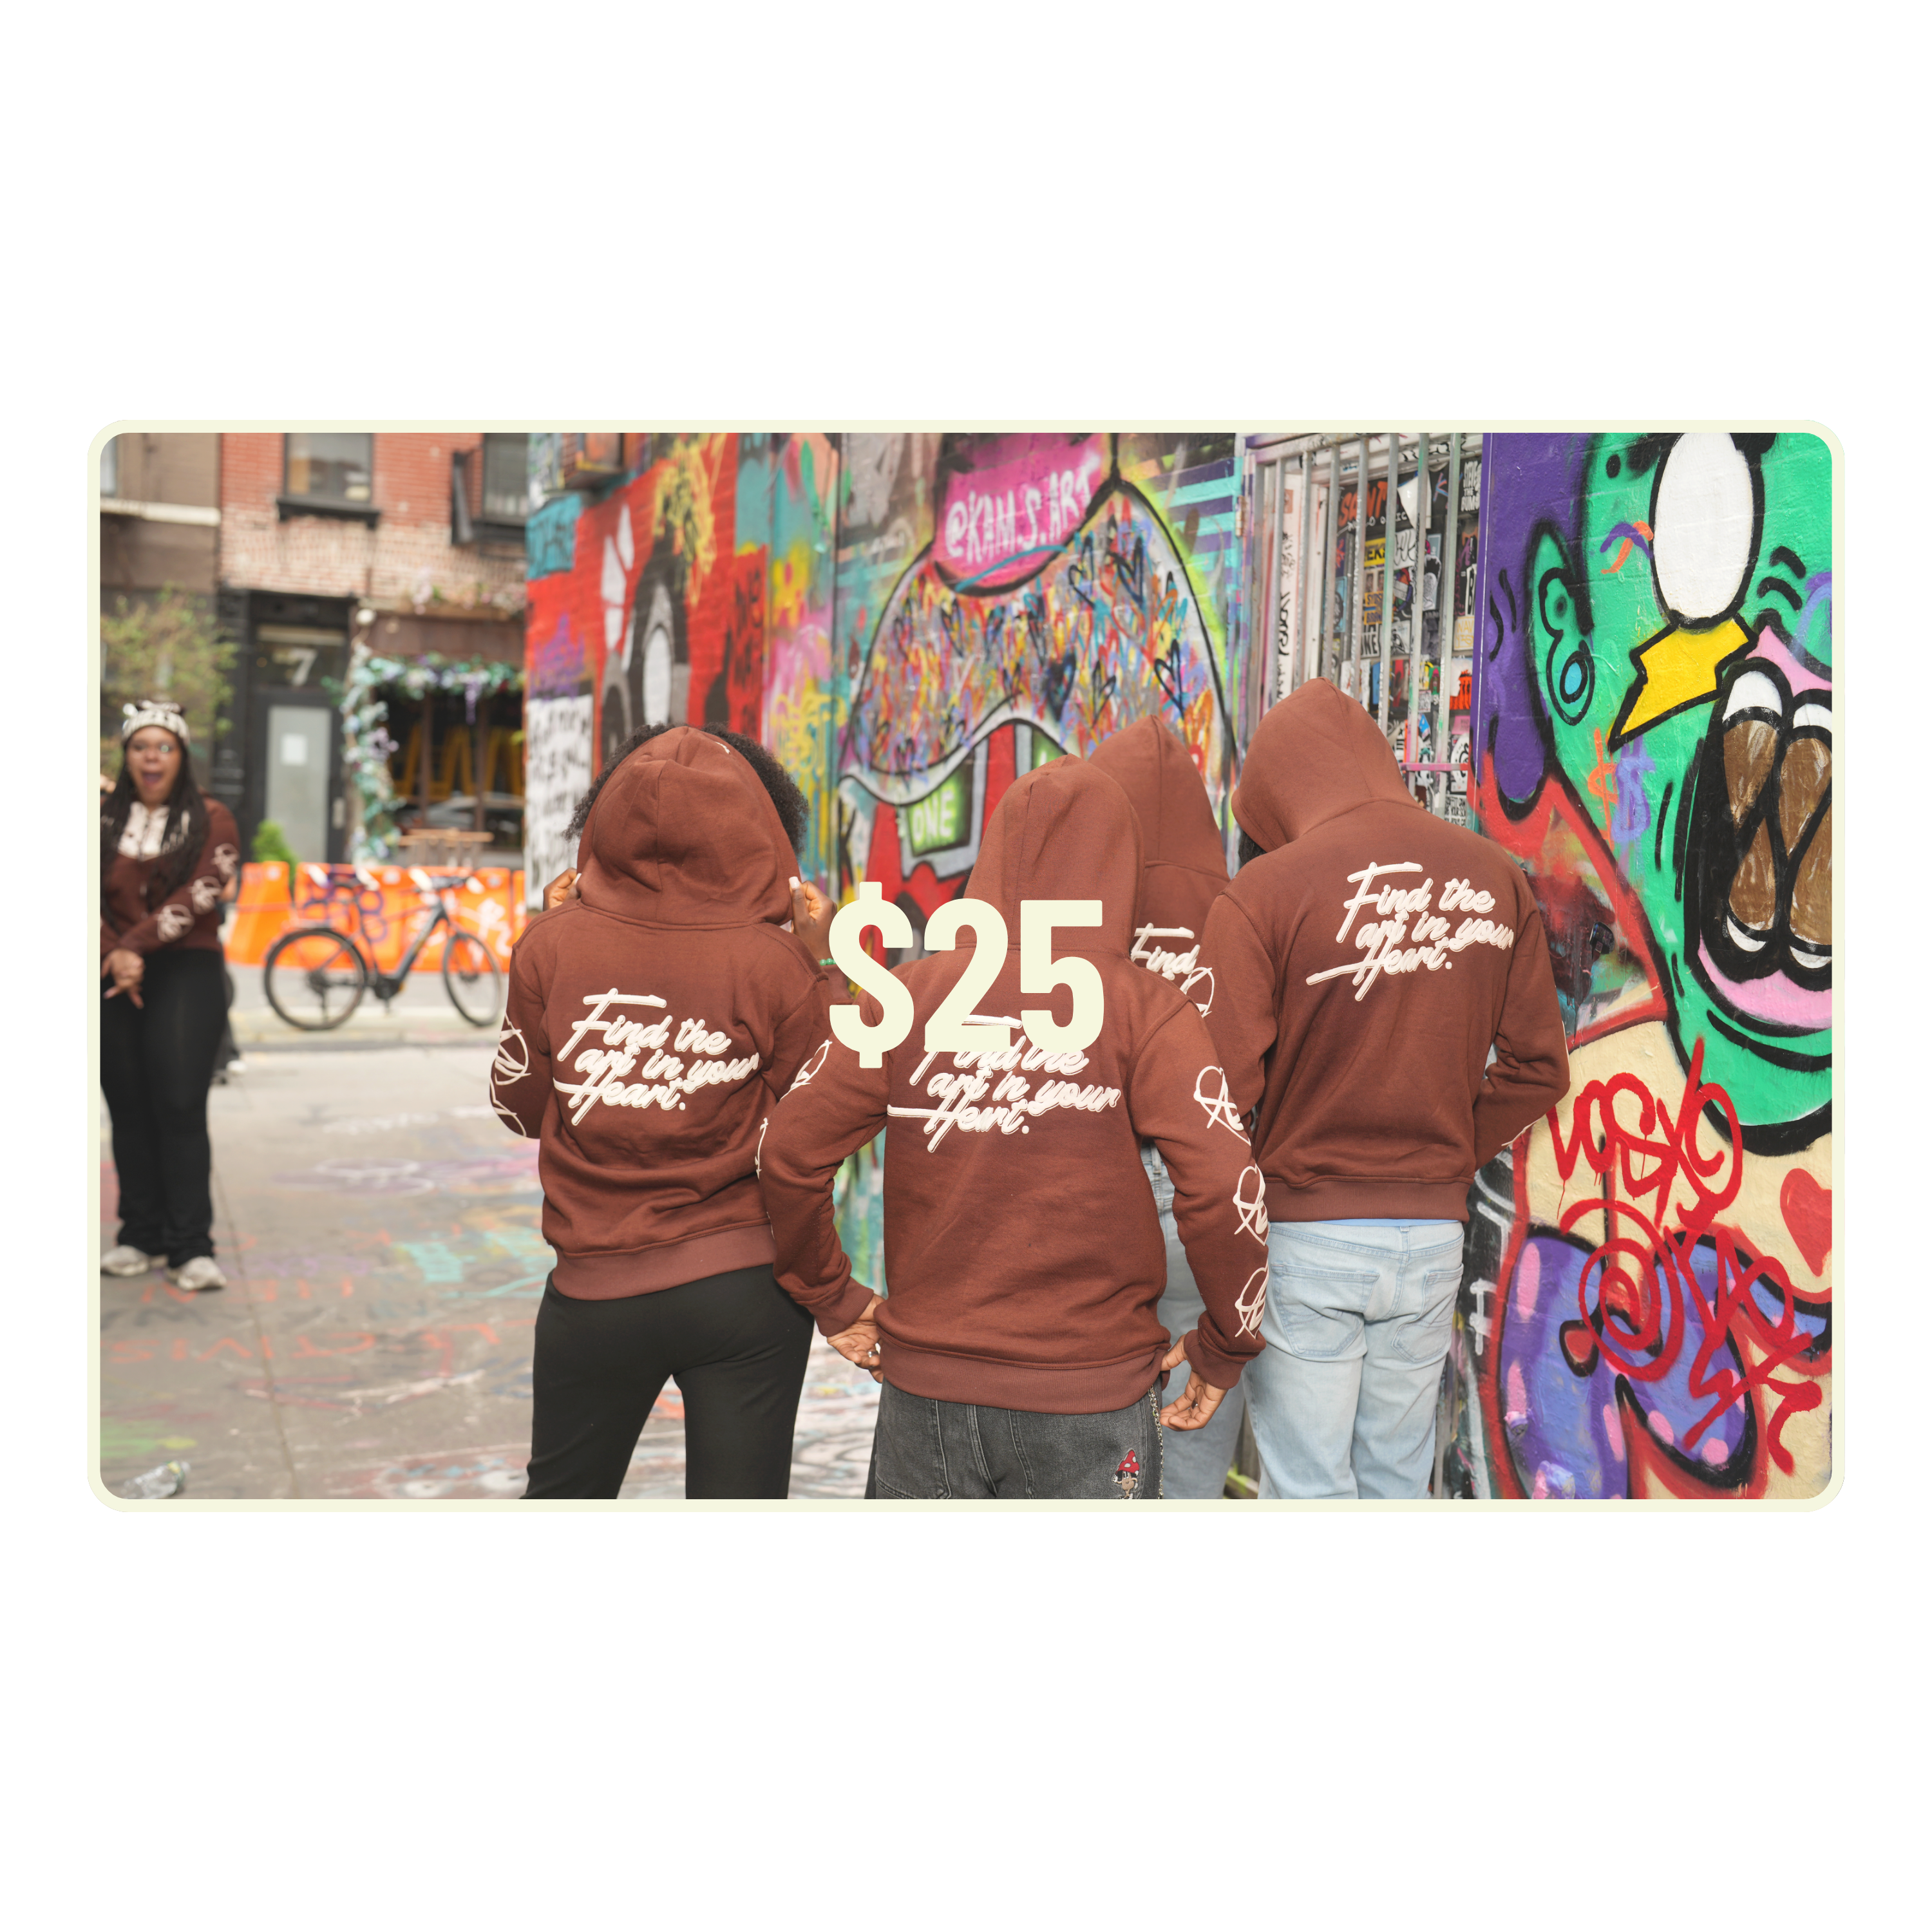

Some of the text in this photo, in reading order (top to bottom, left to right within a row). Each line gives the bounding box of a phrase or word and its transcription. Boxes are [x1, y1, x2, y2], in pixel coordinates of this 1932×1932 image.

[913, 789, 954, 842] ONE
[1336, 862, 1495, 943] Find the
[1356, 911, 1514, 952] art in your
[1305, 935, 1452, 1001] Heart.
[557, 988, 732, 1061] Find the
[553, 1069, 686, 1126] Heart.
[574, 1044, 760, 1094] art in your
[927, 1066, 1121, 1117] art in your
[887, 1094, 1029, 1153] Heart.
